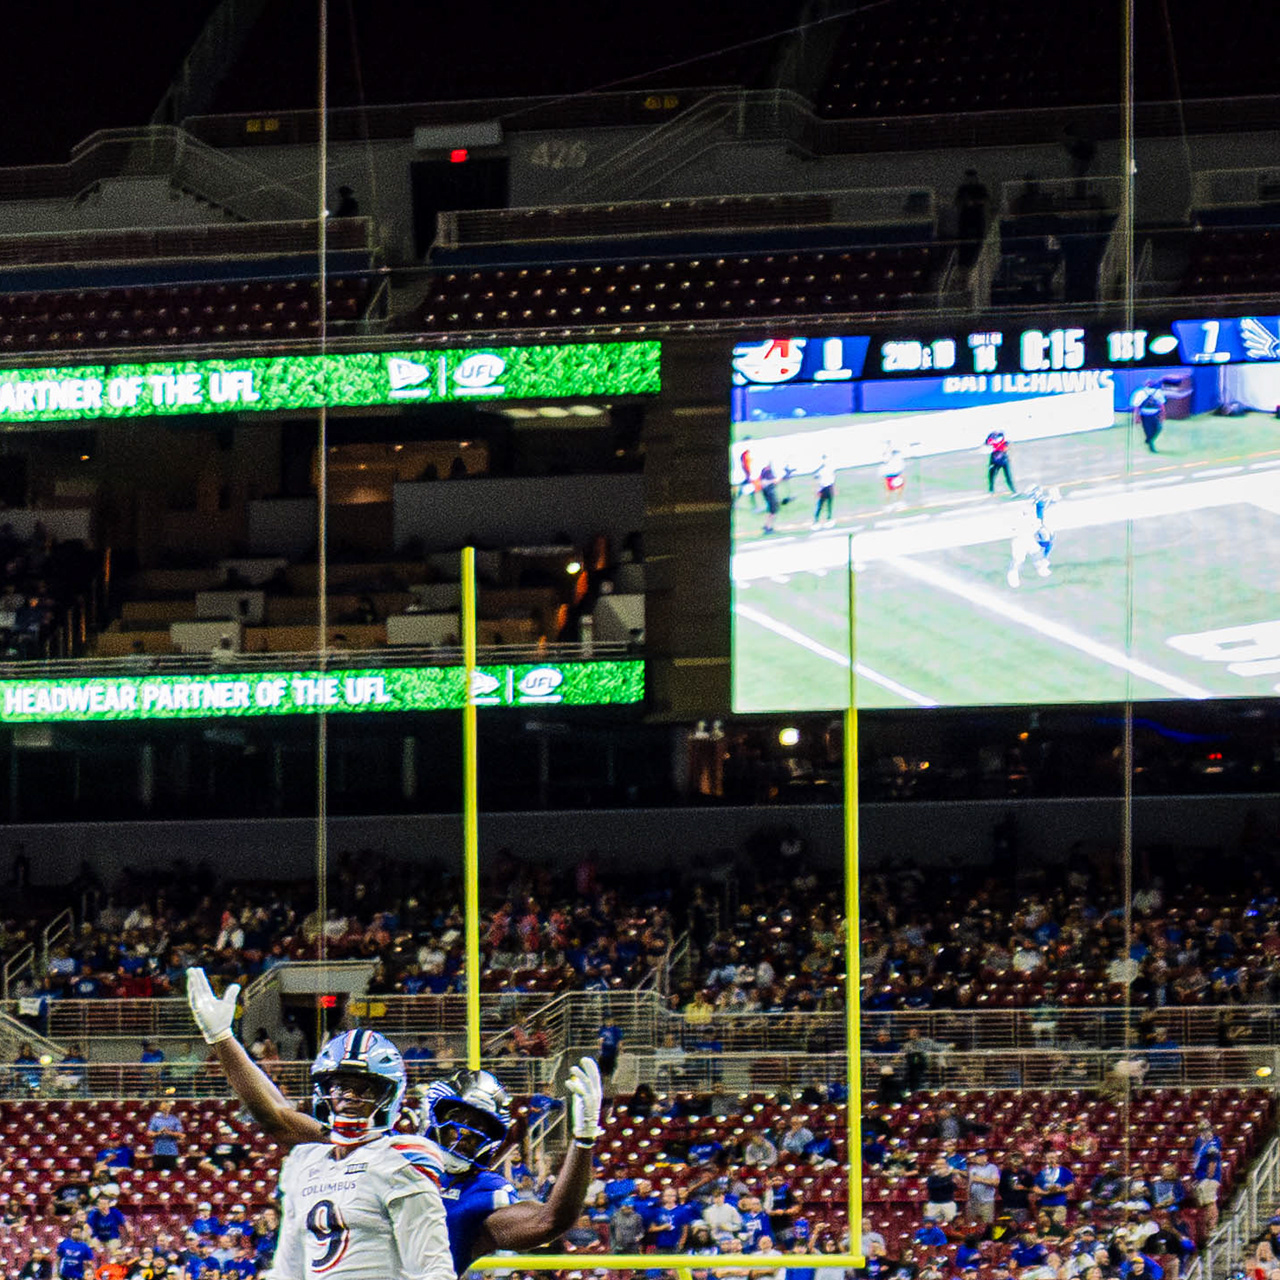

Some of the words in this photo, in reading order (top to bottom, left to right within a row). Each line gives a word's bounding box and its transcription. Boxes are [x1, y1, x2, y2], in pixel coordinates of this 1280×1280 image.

[1022, 330, 1085, 370] 0:15
[108, 377, 143, 407] OF
[149, 373, 202, 406] THE
[210, 371, 260, 402] UFL
[5, 685, 136, 713] HEADWEAR
[143, 681, 251, 710] PARTNER
[256, 680, 287, 707] OF
[293, 678, 339, 705] THE
[346, 677, 390, 703] UFL
[302, 1181, 357, 1197] COLUMBUS
[306, 1199, 349, 1273] 9
